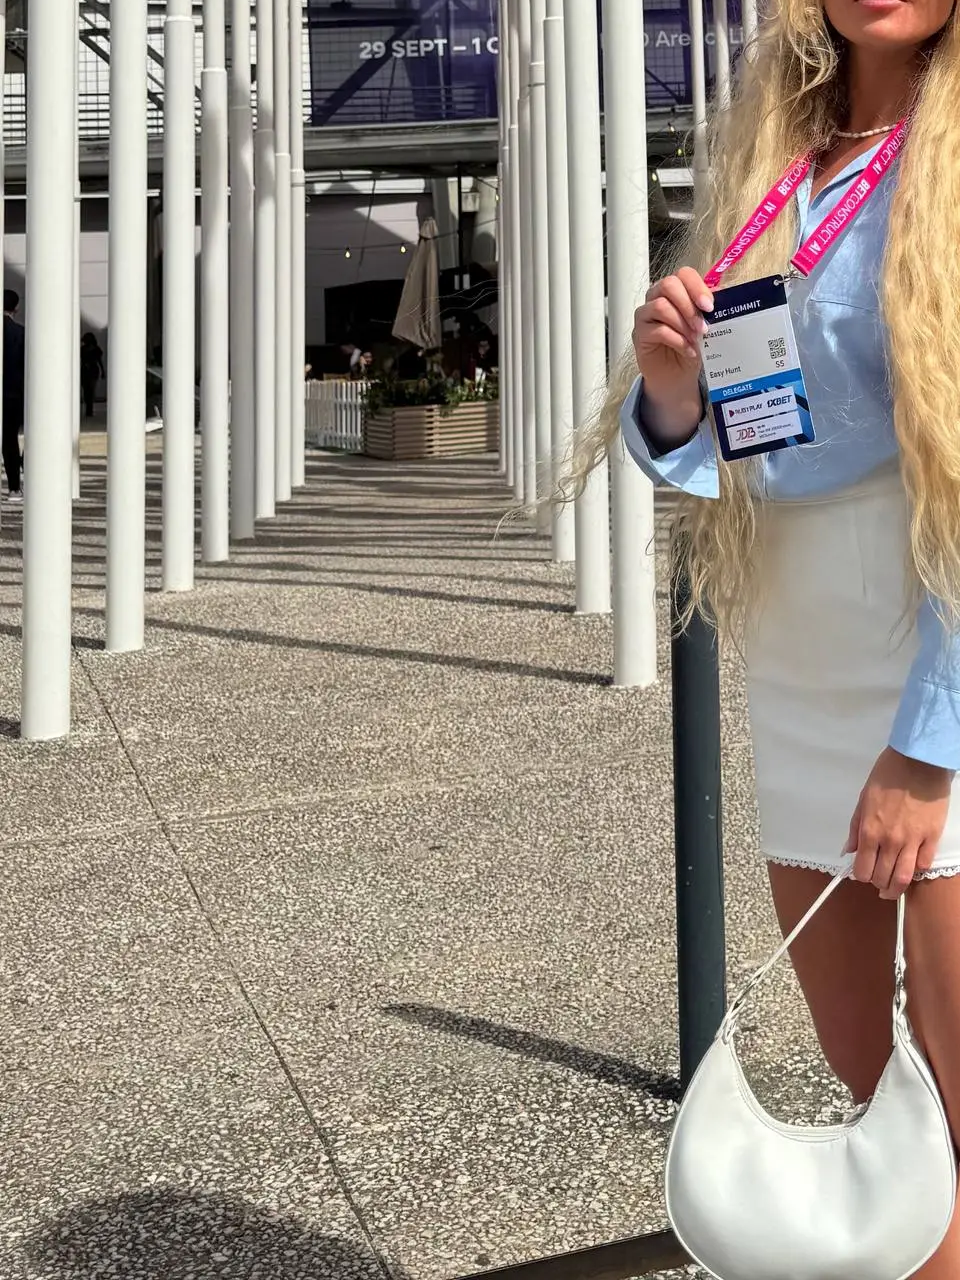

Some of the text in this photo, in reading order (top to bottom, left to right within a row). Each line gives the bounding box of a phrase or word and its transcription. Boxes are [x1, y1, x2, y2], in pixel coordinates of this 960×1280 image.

[359, 41, 386, 60] 29
[391, 38, 448, 59] SEPT
[472, 37, 481, 55] 1
[763, 200, 777, 215] AI
[808, 179, 871, 256] BETCONSTRUCT AI
[709, 370, 725, 379] Easy
[722, 383, 753, 397] DELEGATE
